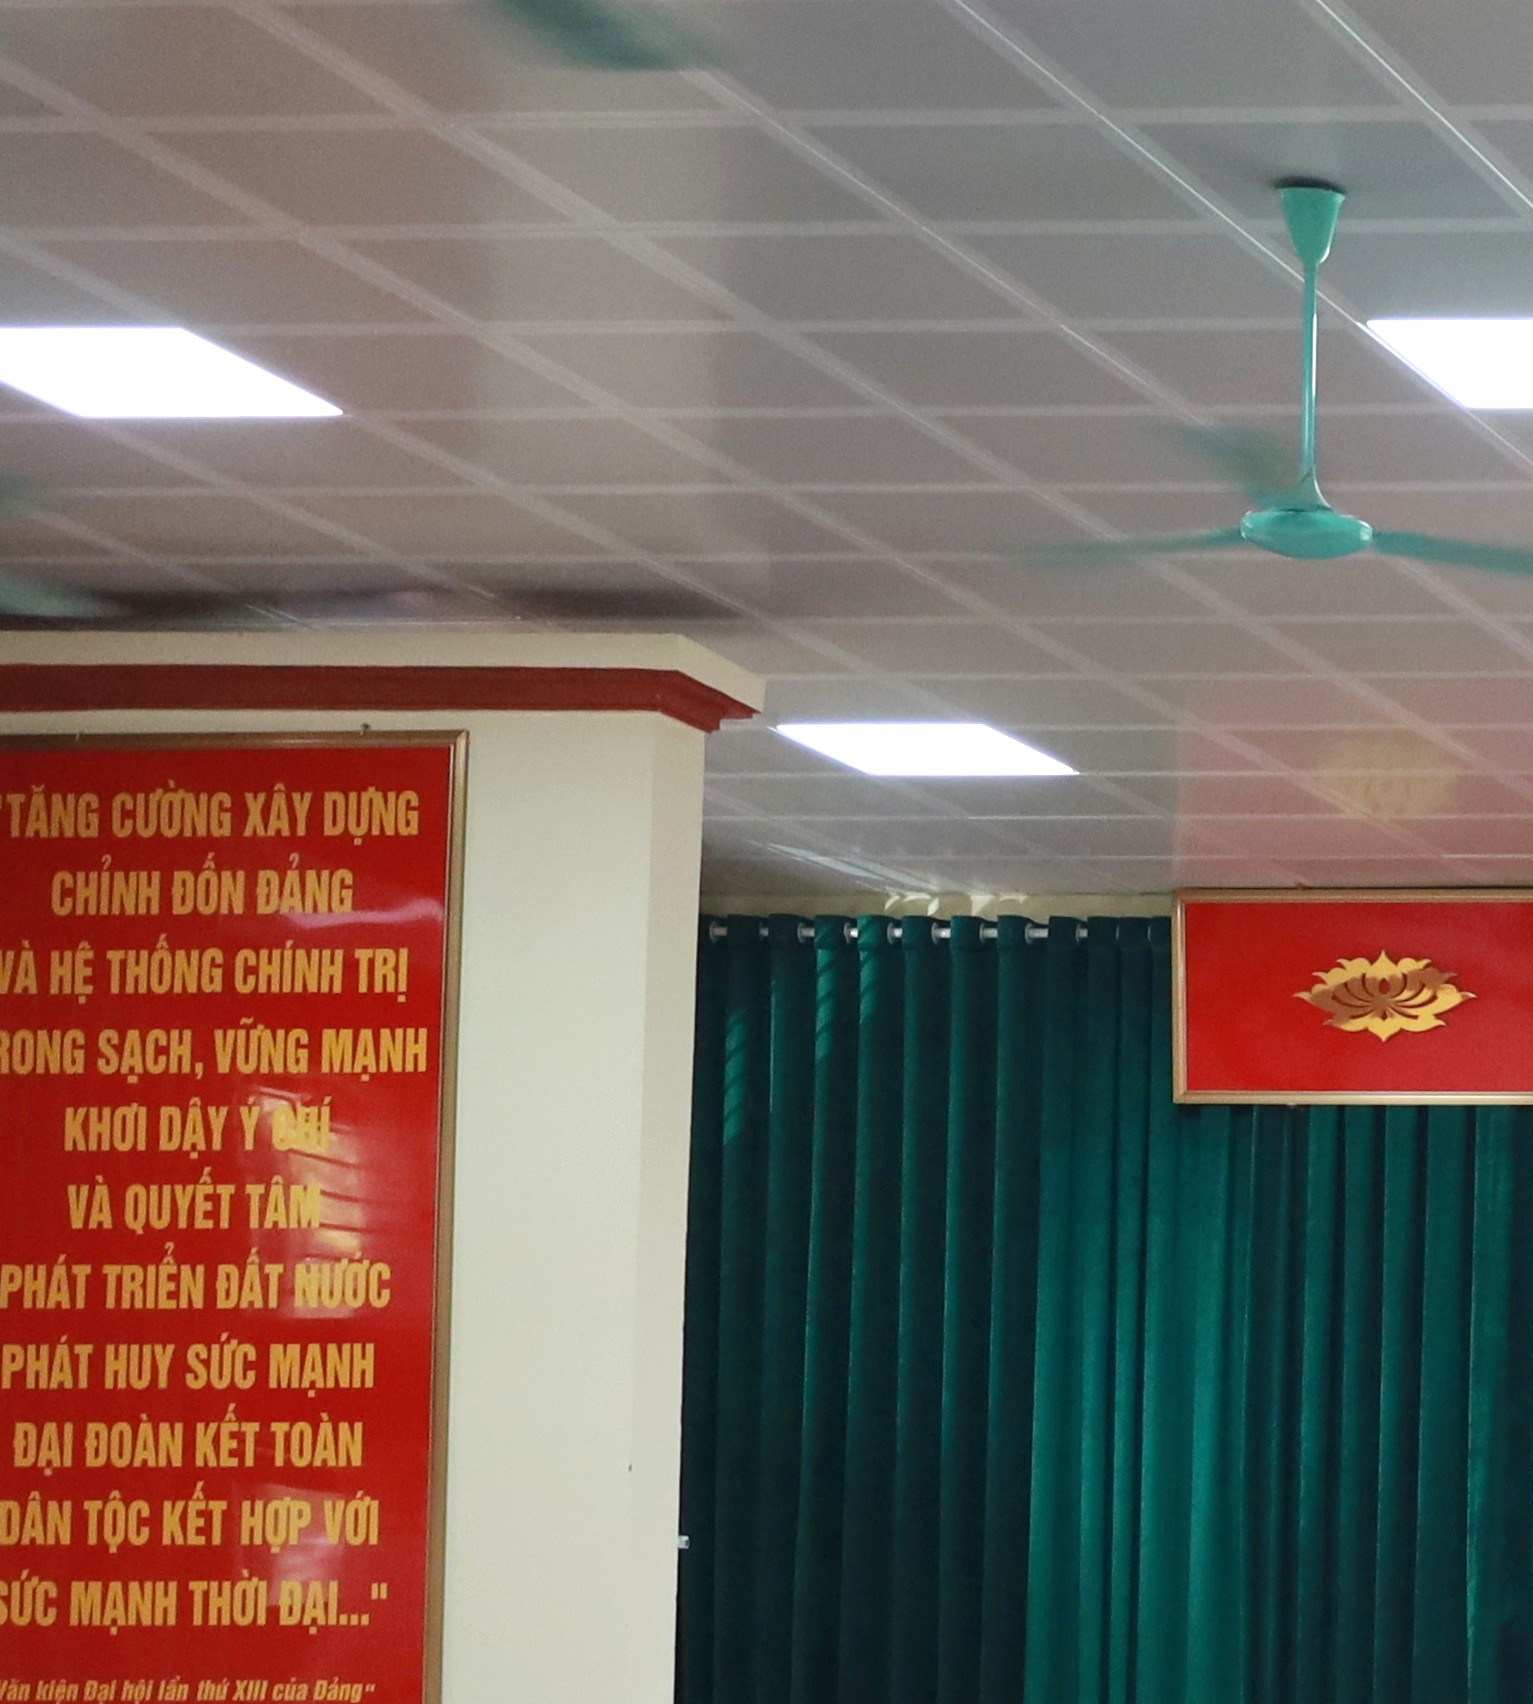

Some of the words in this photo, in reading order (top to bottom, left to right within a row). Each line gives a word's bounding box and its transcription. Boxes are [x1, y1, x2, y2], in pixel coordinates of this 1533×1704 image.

[111, 780, 231, 837] CƯỜNG
[244, 783, 311, 837] XÂY
[323, 787, 419, 845] DỰNG
[51, 855, 160, 916] CHỈNH
[171, 853, 244, 916] ĐỐN
[256, 853, 353, 915] ĐẢNG
[50, 941, 93, 1004] HỆ
[106, 934, 224, 994] THỐNG
[234, 940, 343, 994] CHÍNH
[354, 947, 409, 1002] TRỊ
[98, 1029, 203, 1083] SẠCH,
[214, 1017, 309, 1074] VỮNG
[321, 1028, 428, 1081] MẠNH
[64, 1102, 147, 1151] KHƠI
[159, 1097, 228, 1158] DẬY
[240, 1097, 260, 1150] Ý
[67, 1175, 112, 1229] VÀ
[124, 1166, 235, 1234] QUYẾT
[245, 1175, 321, 1229] TÂM
[0, 1254, 91, 1309] PHÁT
[102, 1242, 205, 1309] TRIỂN
[216, 1247, 284, 1309] ĐẤT
[294, 1251, 391, 1308] NƯỚC
[2, 1334, 93, 1389] PHÁT
[105, 1344, 175, 1389] HUY
[185, 1332, 256, 1389] SỨC
[269, 1343, 375, 1398] MẠNH
[13, 1421, 73, 1476] ĐẠI
[85, 1413, 183, 1468] ĐOÀN
[195, 1403, 260, 1468] KẾT
[269, 1412, 363, 1467] TOÀN
[0, 1491, 72, 1546] DÂN
[84, 1491, 150, 1554] TỘC
[162, 1481, 227, 1546] KẾT
[240, 1495, 311, 1554] HỢP
[323, 1491, 379, 1546] VỚI
[69, 1581, 177, 1636] MẠNH
[188, 1569, 267, 1627] THỜI
[232, 1679, 268, 1701] XIII
